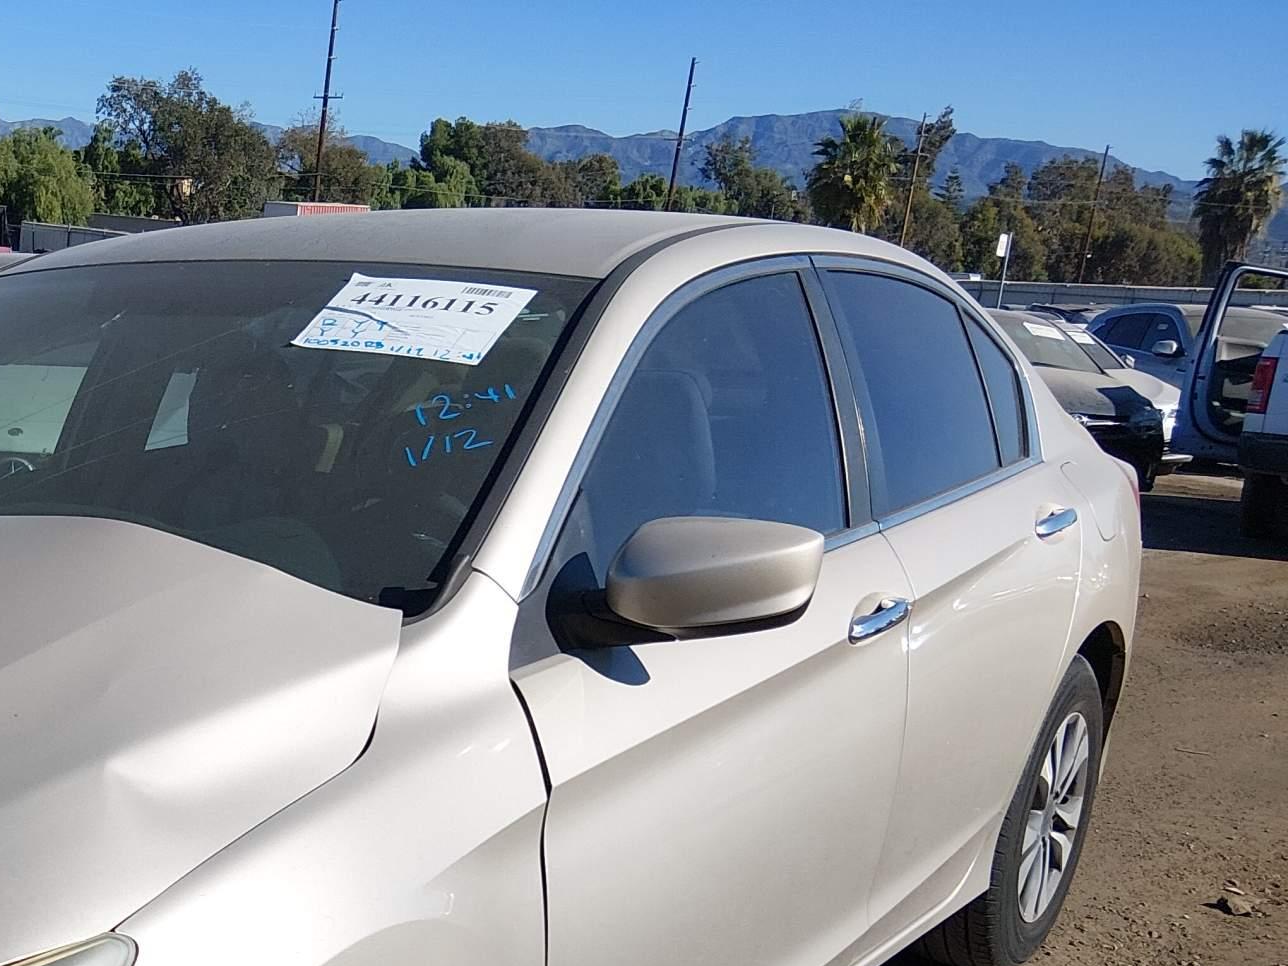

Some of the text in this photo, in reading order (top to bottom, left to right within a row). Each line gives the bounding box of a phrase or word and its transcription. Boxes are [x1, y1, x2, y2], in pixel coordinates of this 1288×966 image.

[350, 292, 500, 317] 44116115
[415, 383, 517, 426] 12:41
[405, 429, 494, 467] 1/12
